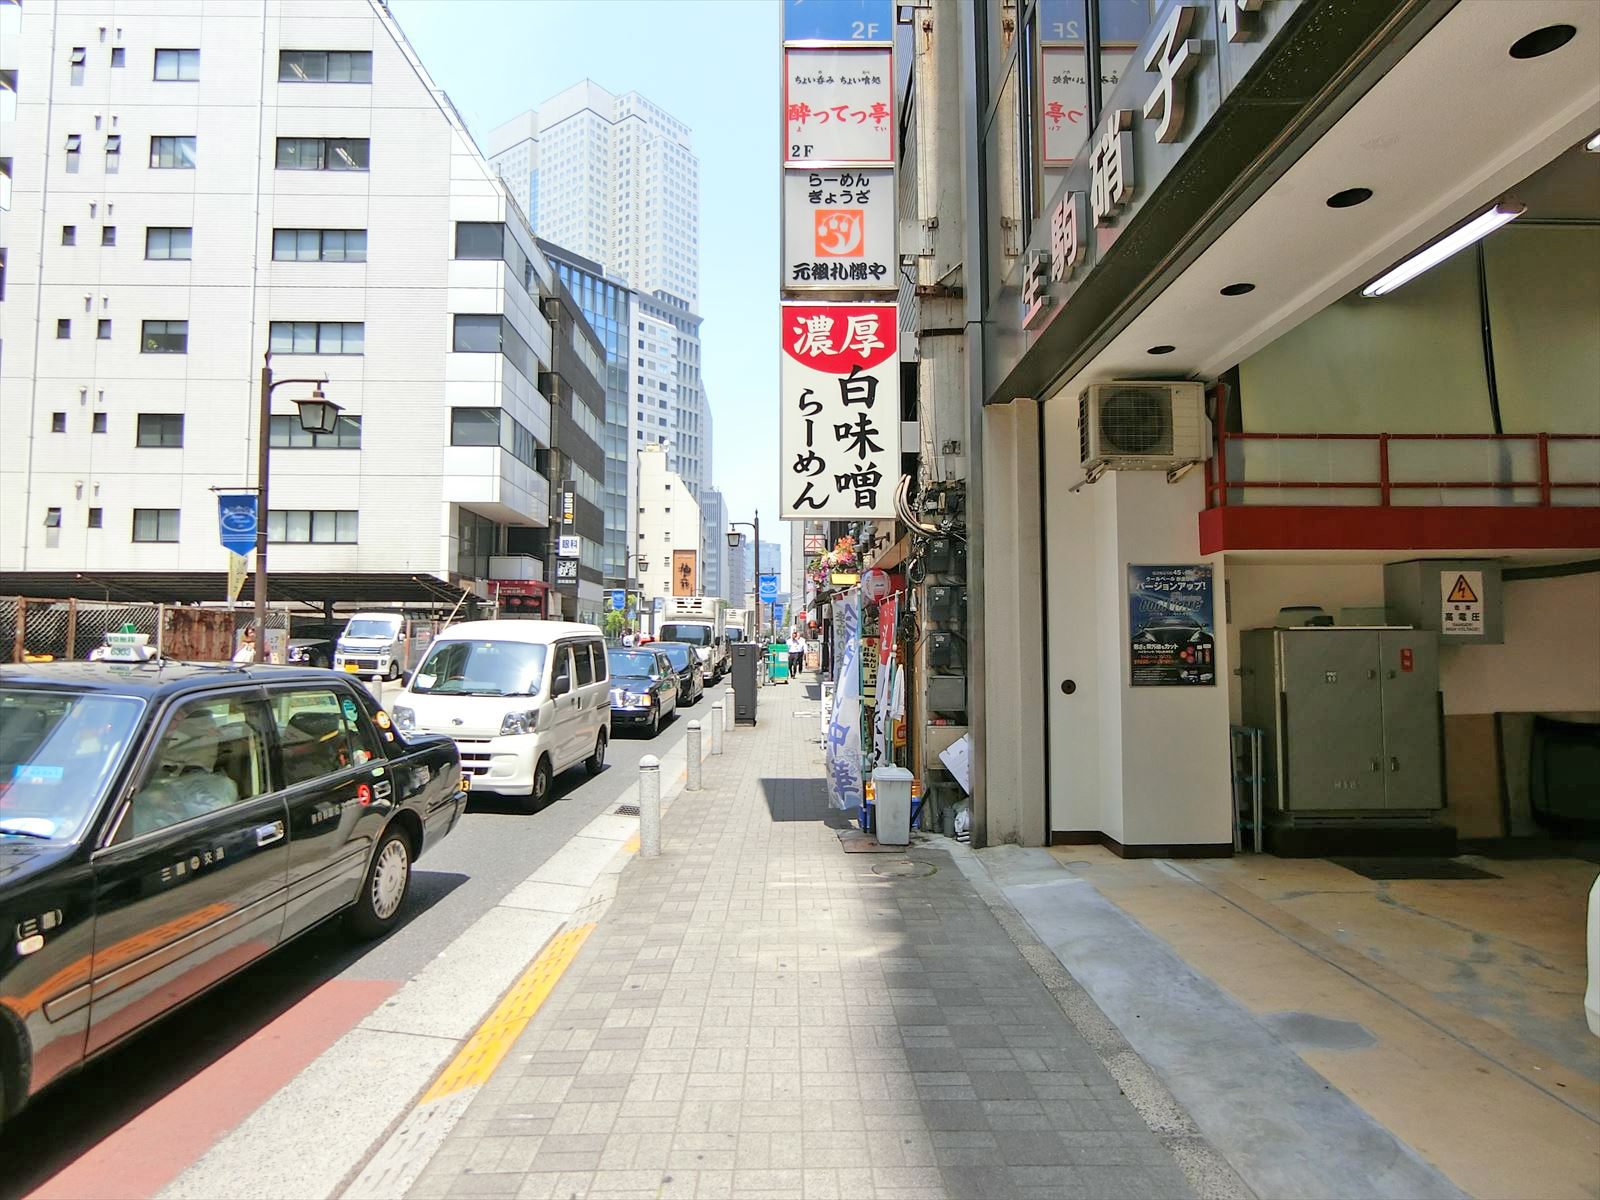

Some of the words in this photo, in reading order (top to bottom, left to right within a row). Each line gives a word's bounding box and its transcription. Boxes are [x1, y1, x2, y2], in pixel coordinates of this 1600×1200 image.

[851, 20, 879, 39] 2F
[788, 102, 889, 124] 酔ってっ亭
[792, 145, 813, 157] 2F
[809, 173, 870, 187] らーめん
[808, 190, 870, 204] ぎょうざ
[792, 262, 887, 280] 元祖札幌や
[793, 314, 885, 358] 濃厚
[834, 364, 885, 510] 白味噌
[793, 388, 830, 510] らーめん
